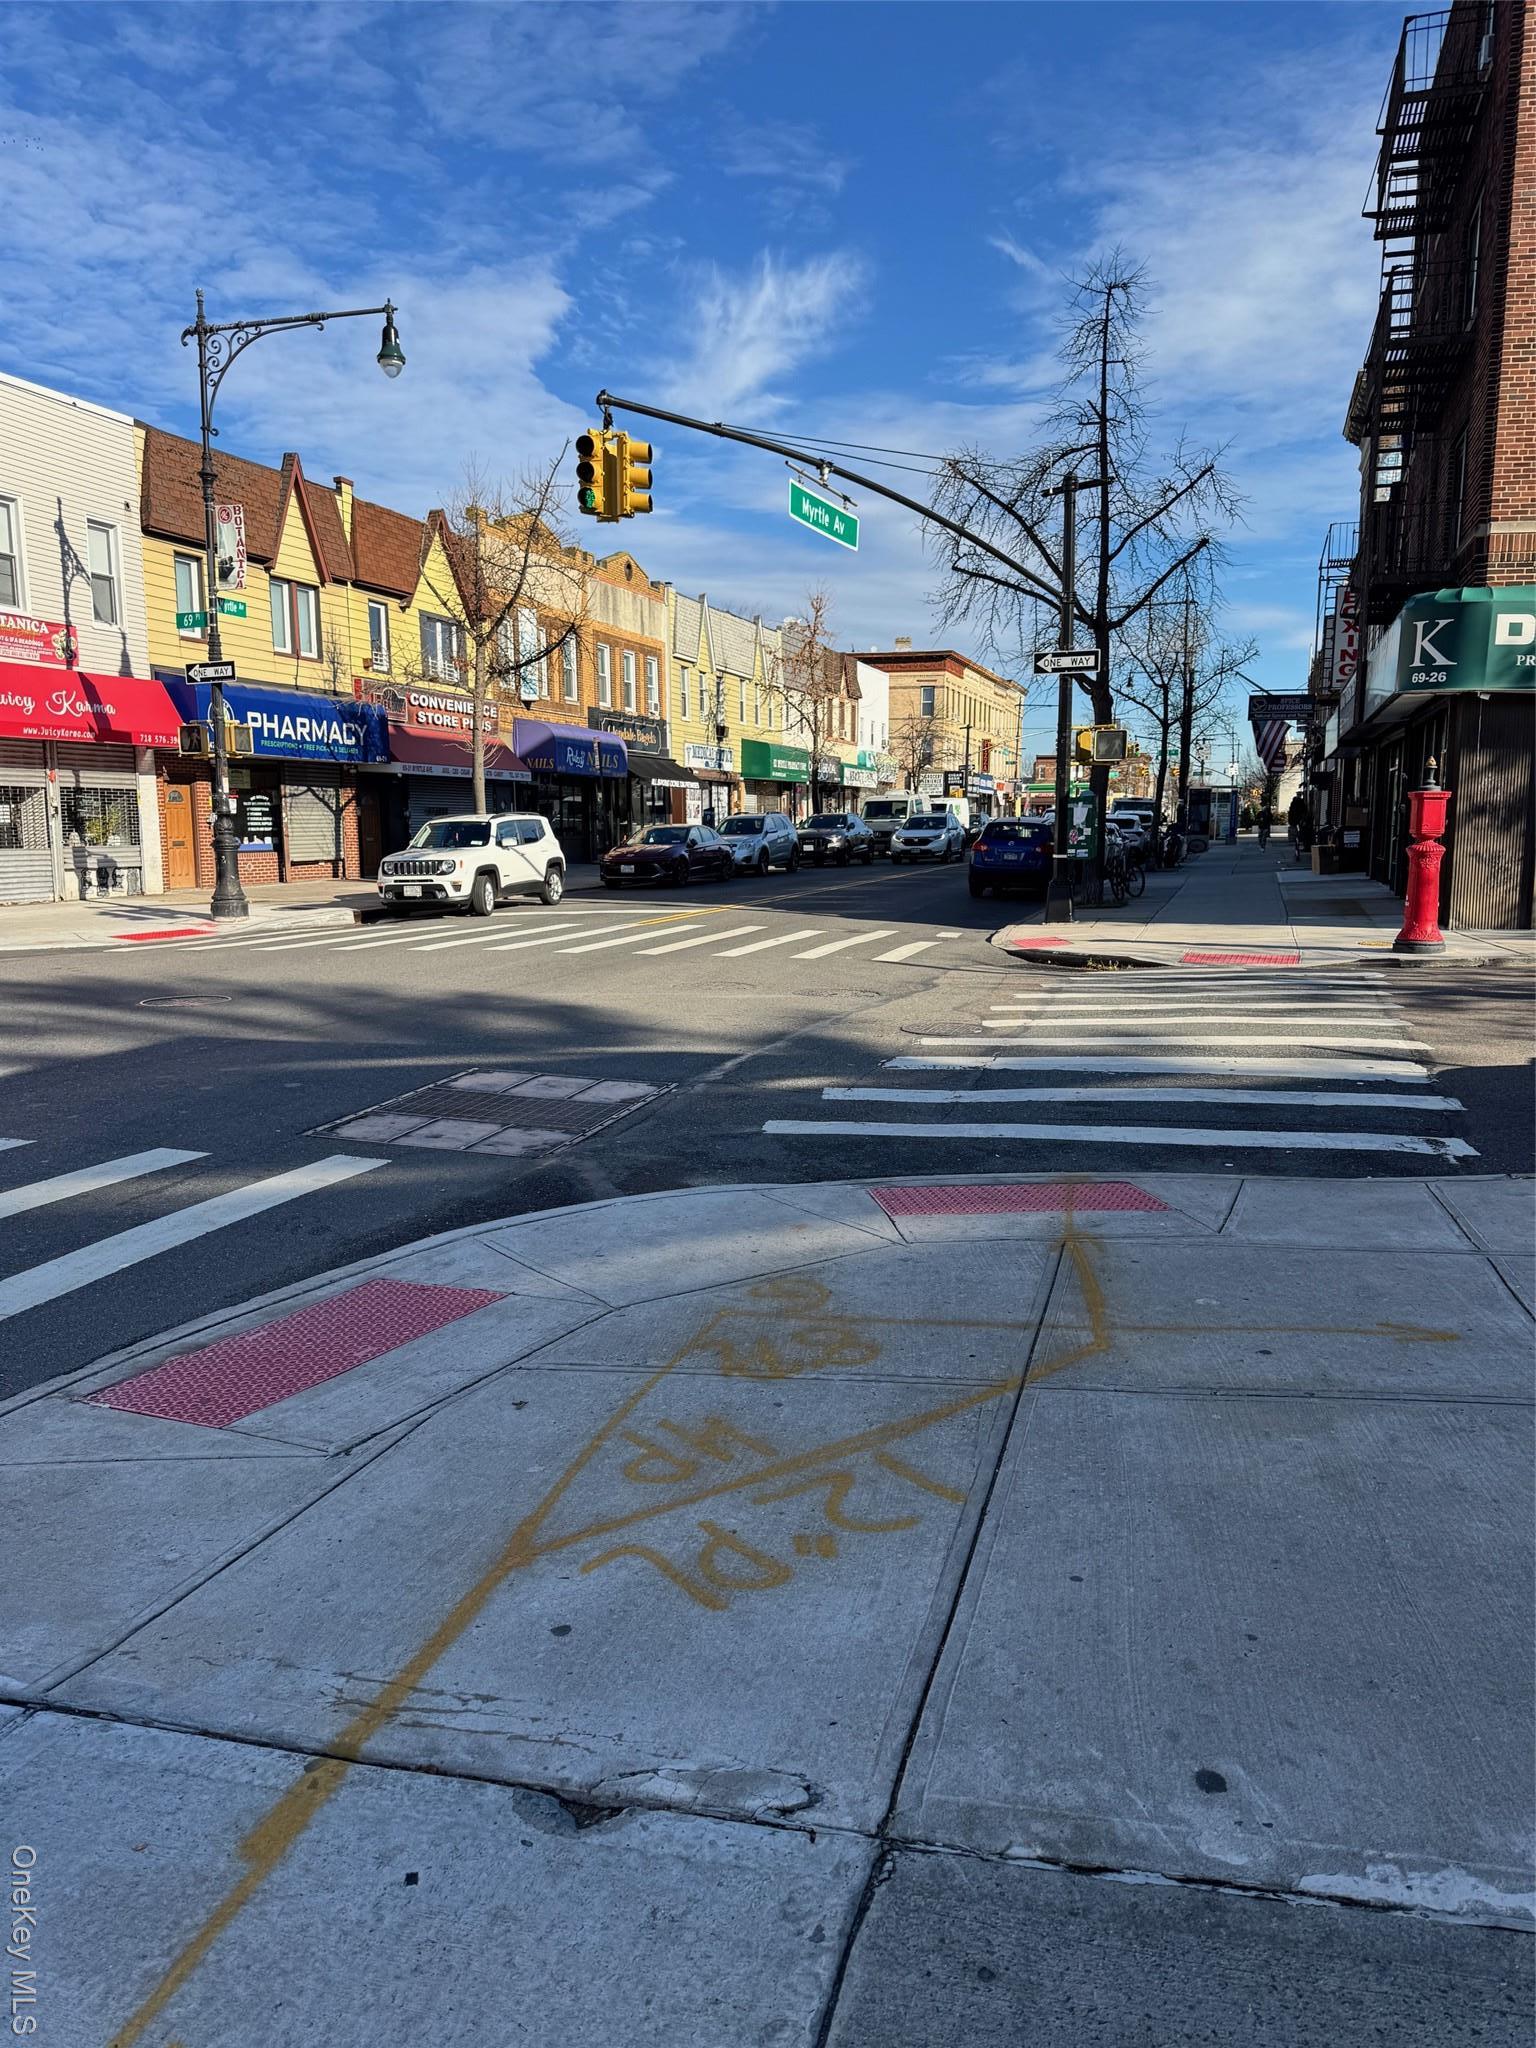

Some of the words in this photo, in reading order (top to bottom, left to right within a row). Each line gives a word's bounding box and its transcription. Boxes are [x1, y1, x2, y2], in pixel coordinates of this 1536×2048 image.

[802, 496, 830, 527] Myrtle
[833, 515, 845, 535] Av
[233, 505, 247, 590] BOTANICA
[183, 614, 194, 627] 69
[1494, 613, 1536, 646] D
[1408, 618, 1458, 668] K
[1043, 658, 1062, 668] ONE
[1070, 657, 1091, 666] WAY
[193, 668, 208, 678] ONE
[214, 666, 230, 676] WAY
[1411, 671, 1447, 684] 69-26
[45, 690, 117, 718] Karma
[409, 692, 498, 718] CONVENIECE
[416, 711, 459, 727] STORE
[247, 711, 368, 746] PHARMACY
[140, 733, 152, 743] 718
[636, 729, 657, 747] Bagels
[527, 757, 554, 769] NAILS
[586, 752, 619, 769] NILS
